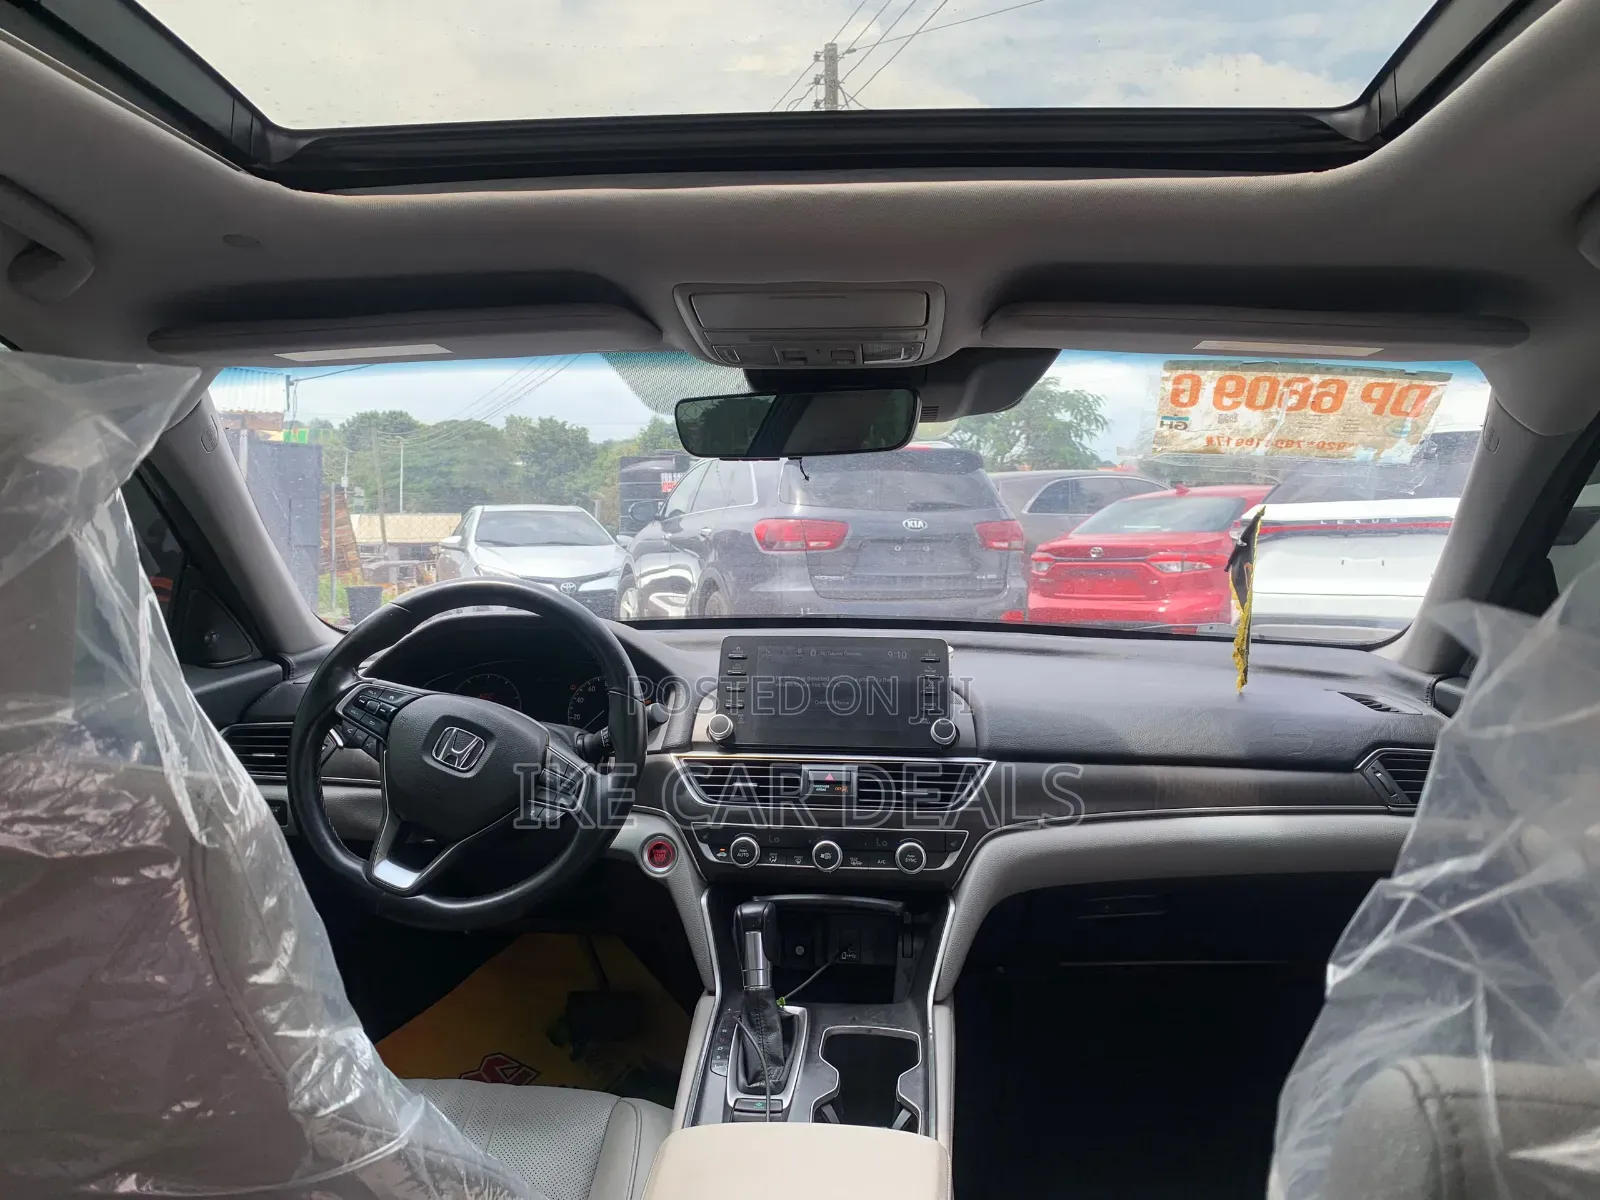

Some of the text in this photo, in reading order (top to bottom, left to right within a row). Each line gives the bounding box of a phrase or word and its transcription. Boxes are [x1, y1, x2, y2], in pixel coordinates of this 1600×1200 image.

[1319, 517, 1398, 525] LEXUS
[887, 650, 908, 660] 9:10
[768, 834, 780, 844] Lo
[876, 837, 888, 847] Lo
